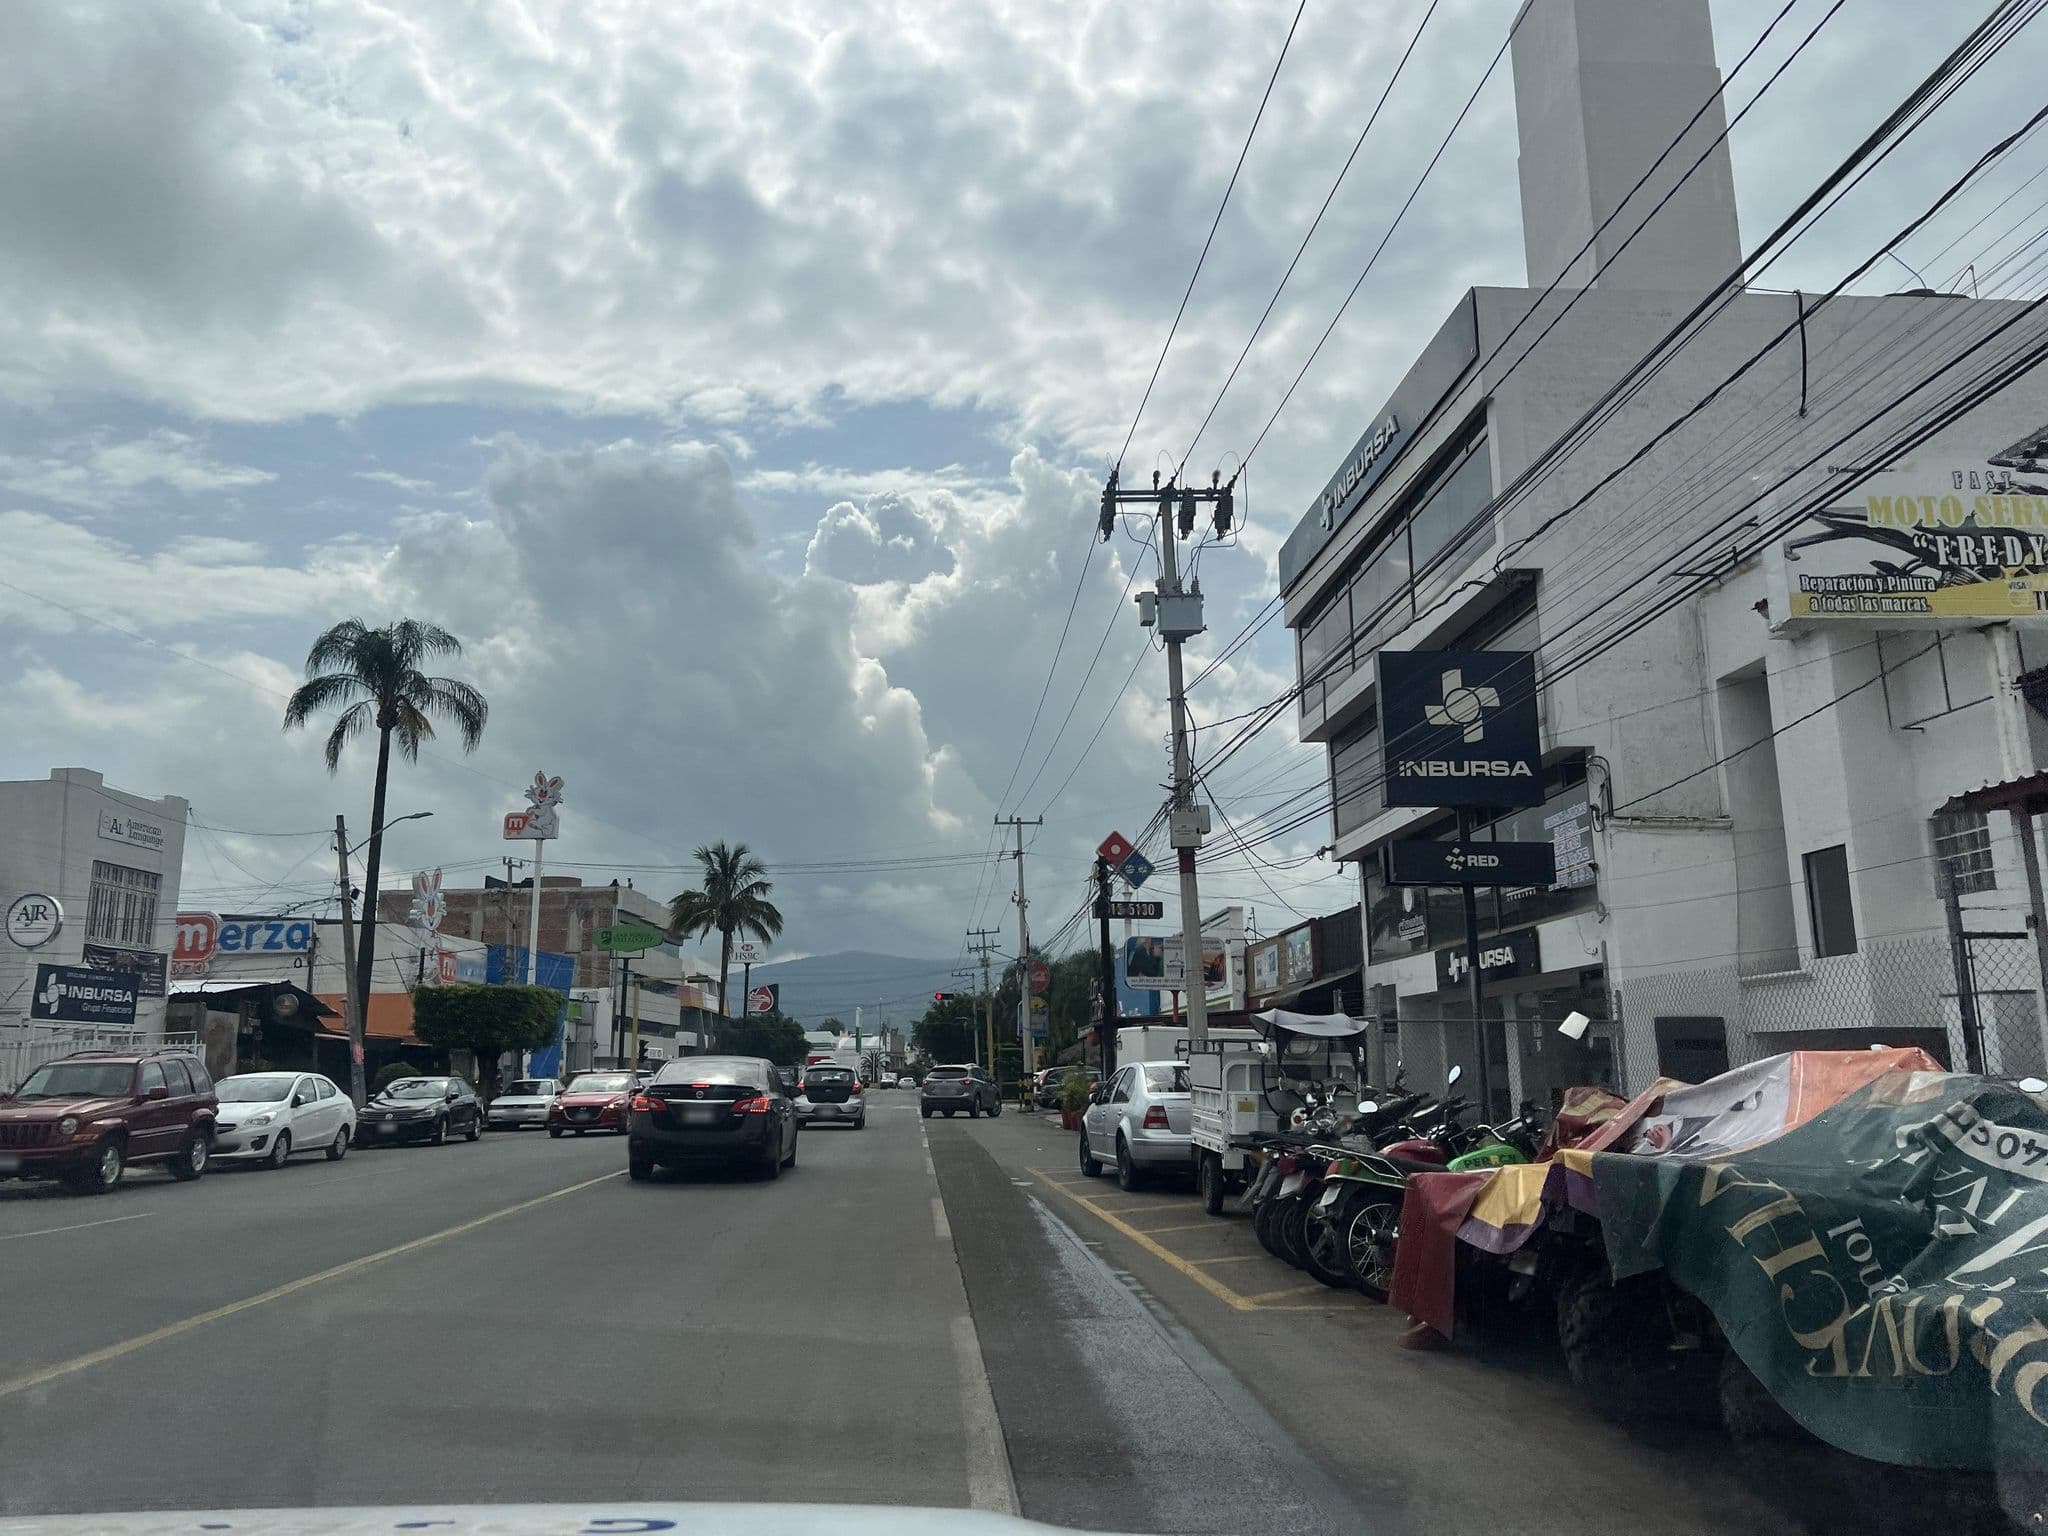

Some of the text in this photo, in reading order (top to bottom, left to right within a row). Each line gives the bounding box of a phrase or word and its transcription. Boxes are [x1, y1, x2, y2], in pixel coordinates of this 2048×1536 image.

[1333, 415, 1399, 508] INBURSA
[1952, 471, 2012, 490] FAST
[1867, 496, 1963, 527] MOTO
[1800, 575, 1936, 593] Reparación y Pintura
[1810, 599, 1820, 612] a
[1820, 596, 1857, 613] todas
[1858, 597, 1879, 612] las
[1399, 760, 1533, 777] INBURSA
[1467, 855, 1499, 867] RED
[16, 904, 48, 927] AJR
[177, 921, 311, 952] merza
[735, 952, 760, 961] HSBC
[67, 985, 133, 1003] INBURSA
